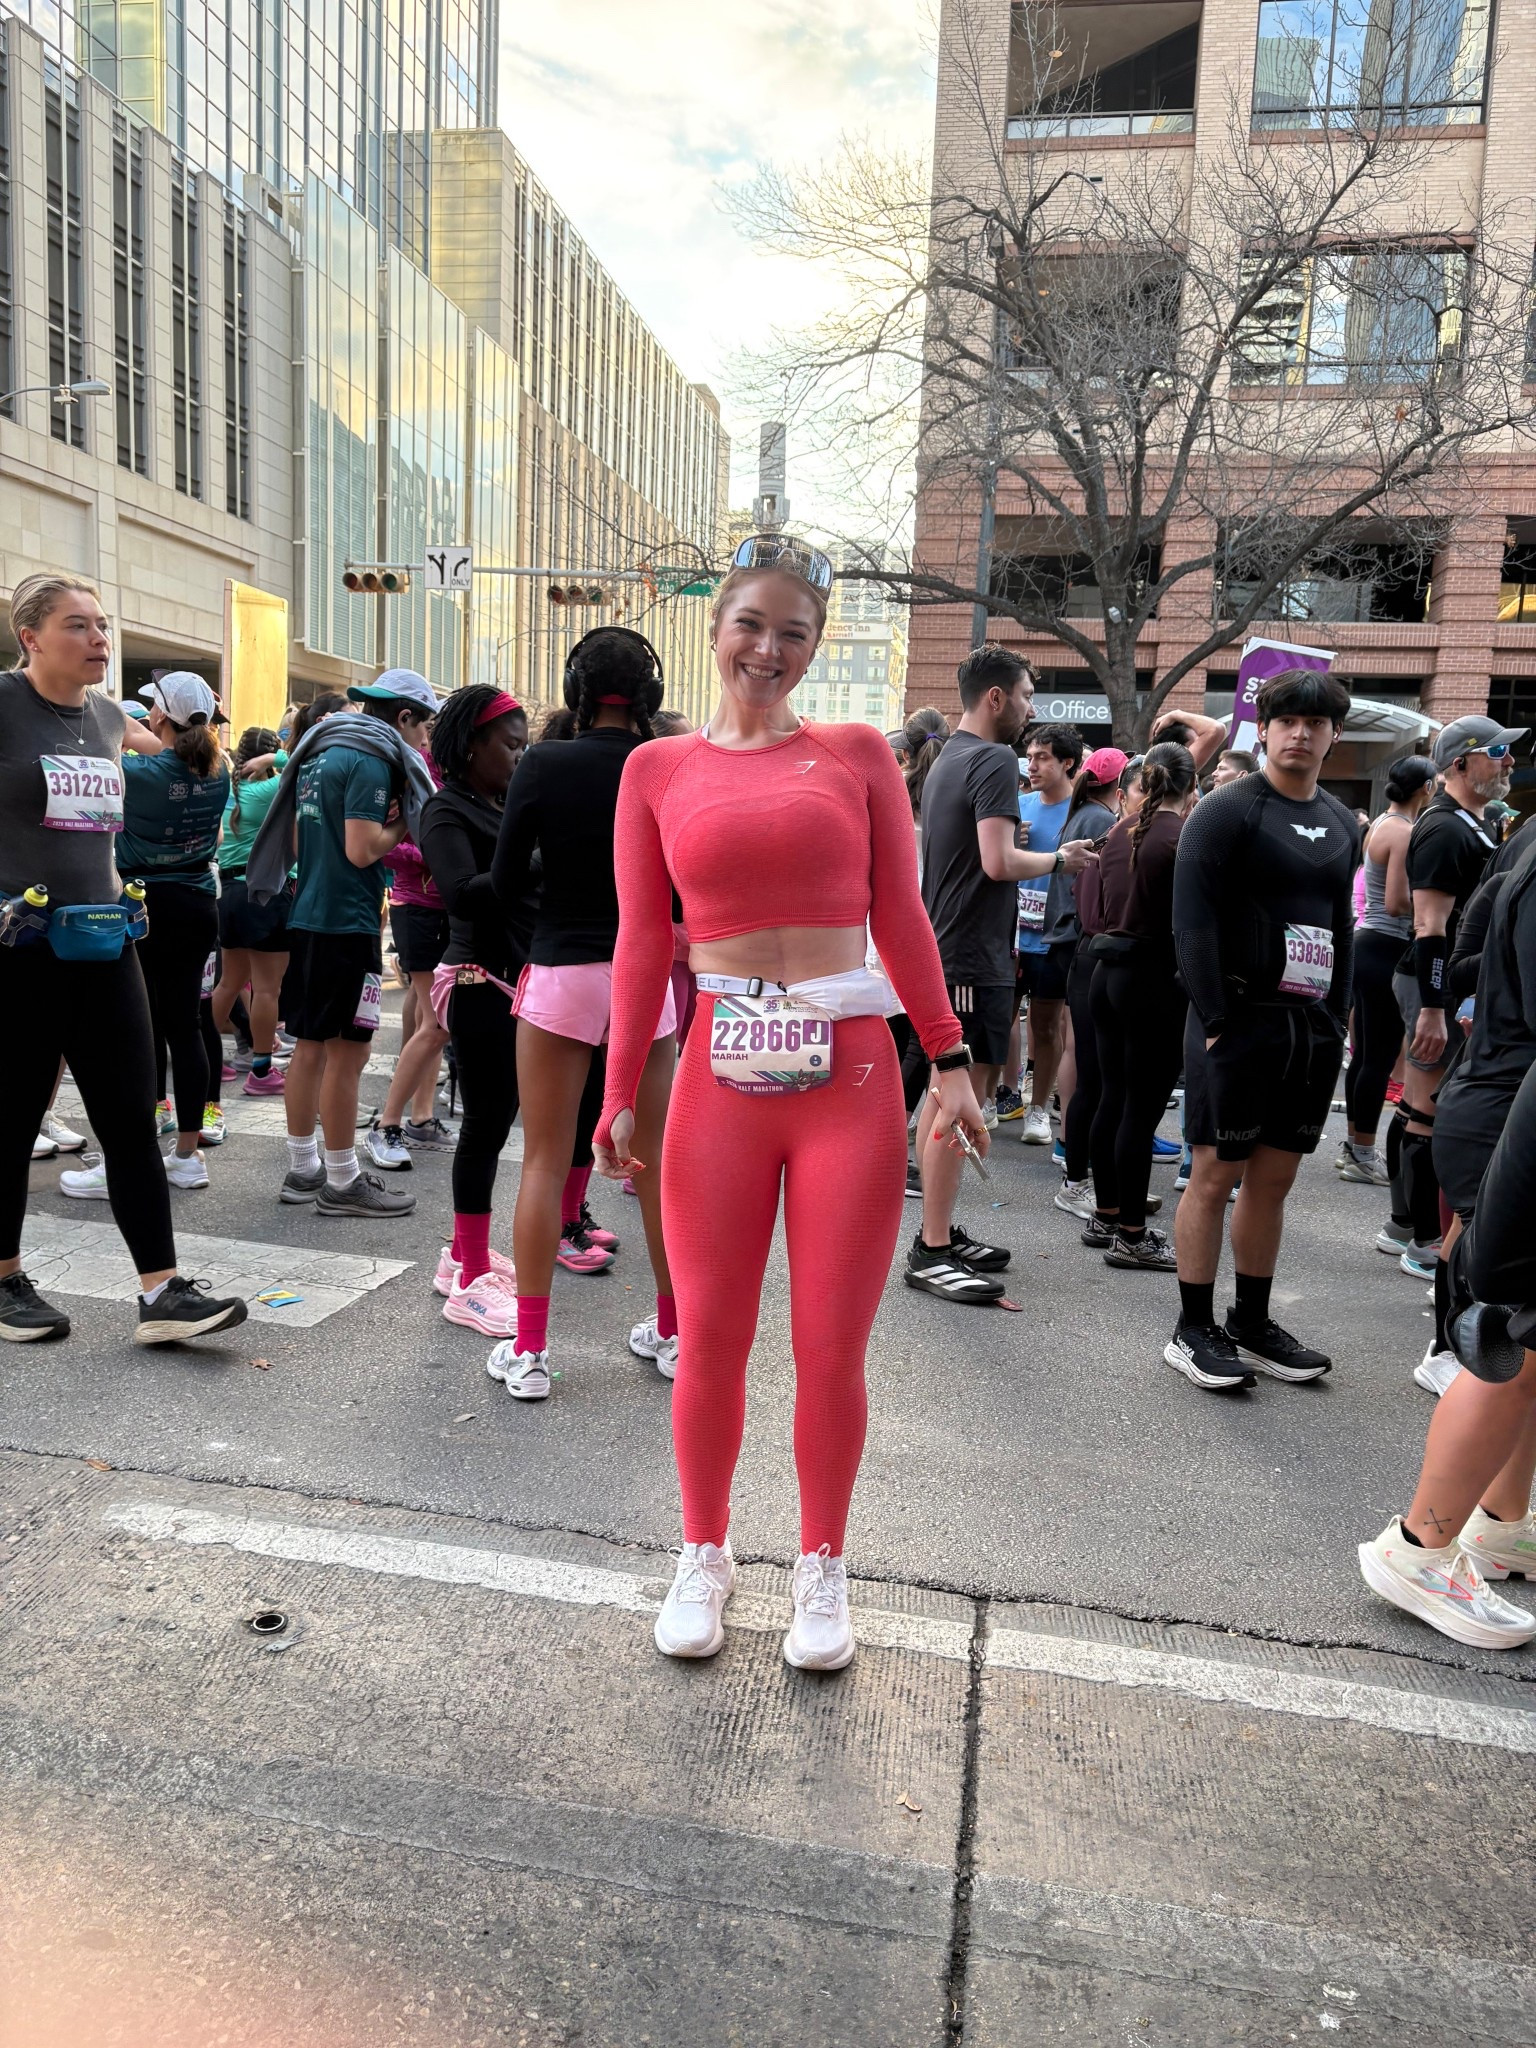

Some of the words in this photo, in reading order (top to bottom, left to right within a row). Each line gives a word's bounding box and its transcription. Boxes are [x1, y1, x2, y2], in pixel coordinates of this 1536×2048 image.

[825, 622, 852, 632] dence
[1050, 700, 1109, 719] Office
[49, 772, 103, 797] 33122
[1288, 939, 1327, 967] 33836
[696, 976, 731, 989] ELT
[766, 1000, 778, 1009] 35
[713, 1020, 801, 1053] 22866
[810, 1022, 822, 1043] J
[466, 1298, 487, 1315] HOKA
[1177, 1335, 1195, 1360] HOKA
